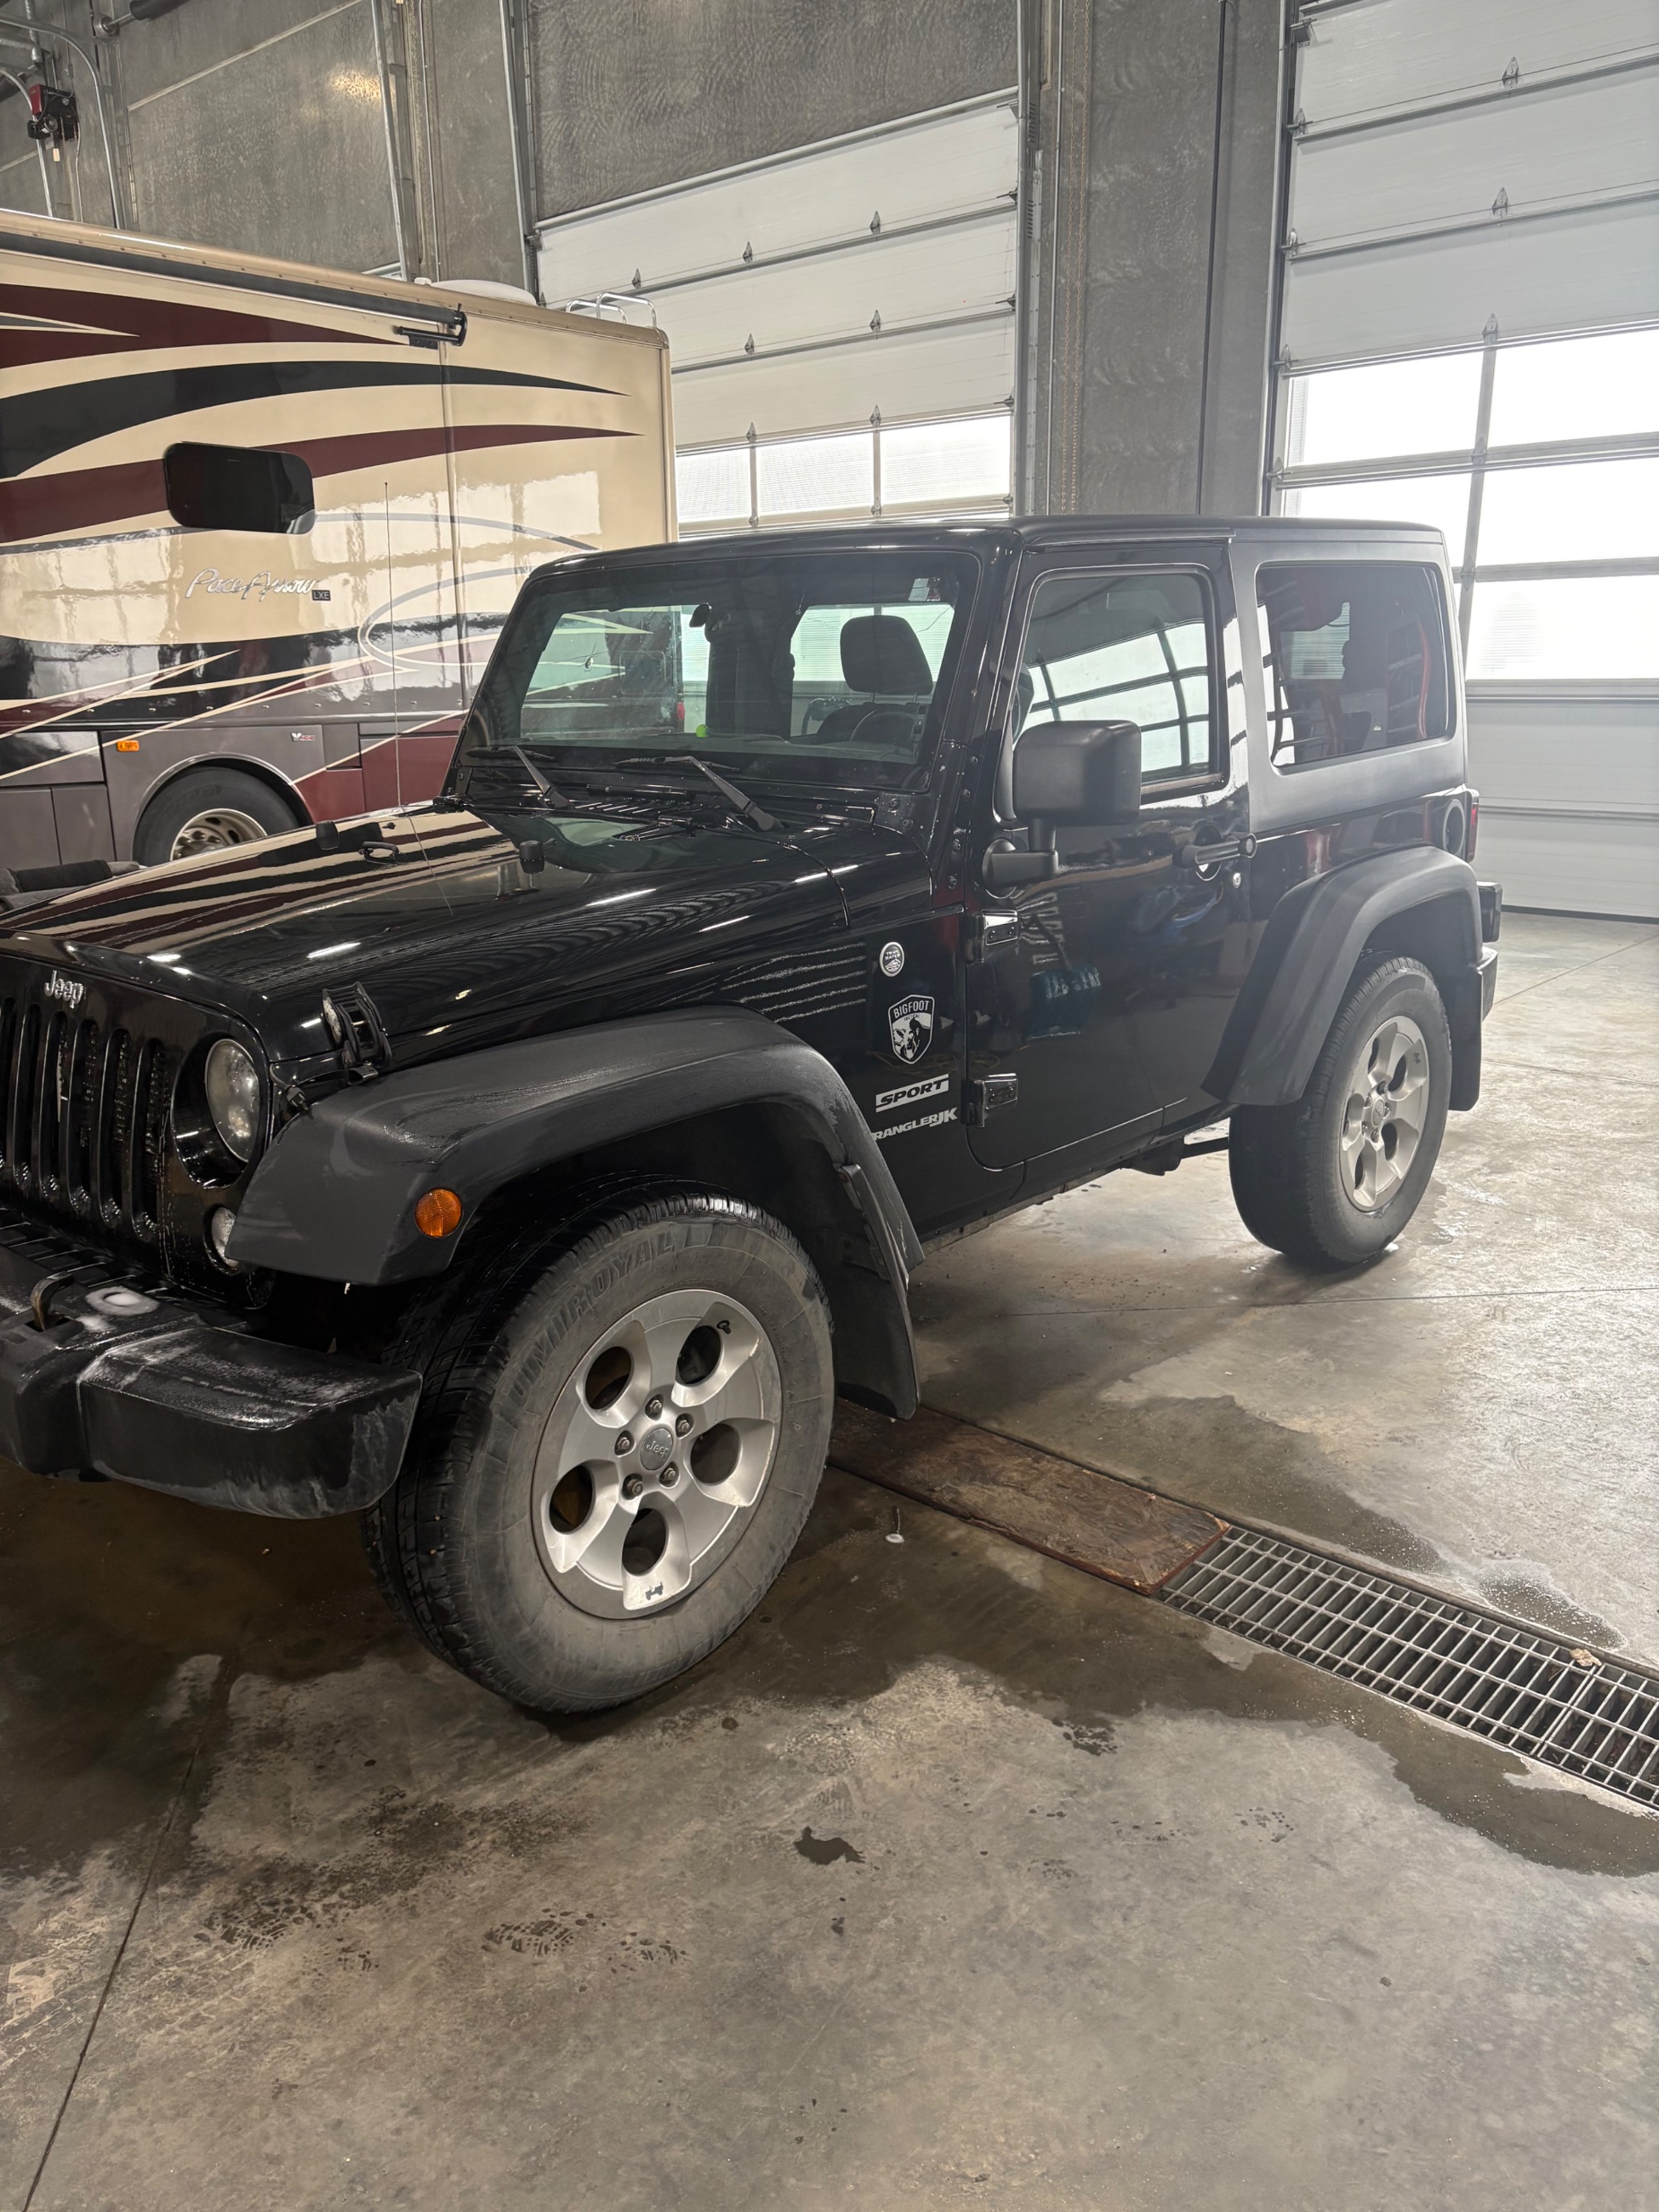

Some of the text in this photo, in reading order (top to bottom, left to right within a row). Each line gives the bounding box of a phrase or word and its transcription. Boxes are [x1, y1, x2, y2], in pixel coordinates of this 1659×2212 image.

[185, 568, 320, 602] Pace Arrow
[312, 590, 331, 601] LXE
[44, 970, 84, 1009] Jeep
[893, 1000, 930, 1019] BIGFOOT
[878, 1078, 947, 1107] SPORT
[504, 1230, 676, 1402] UNIROYAL
[646, 1440, 670, 1458] Jeep
